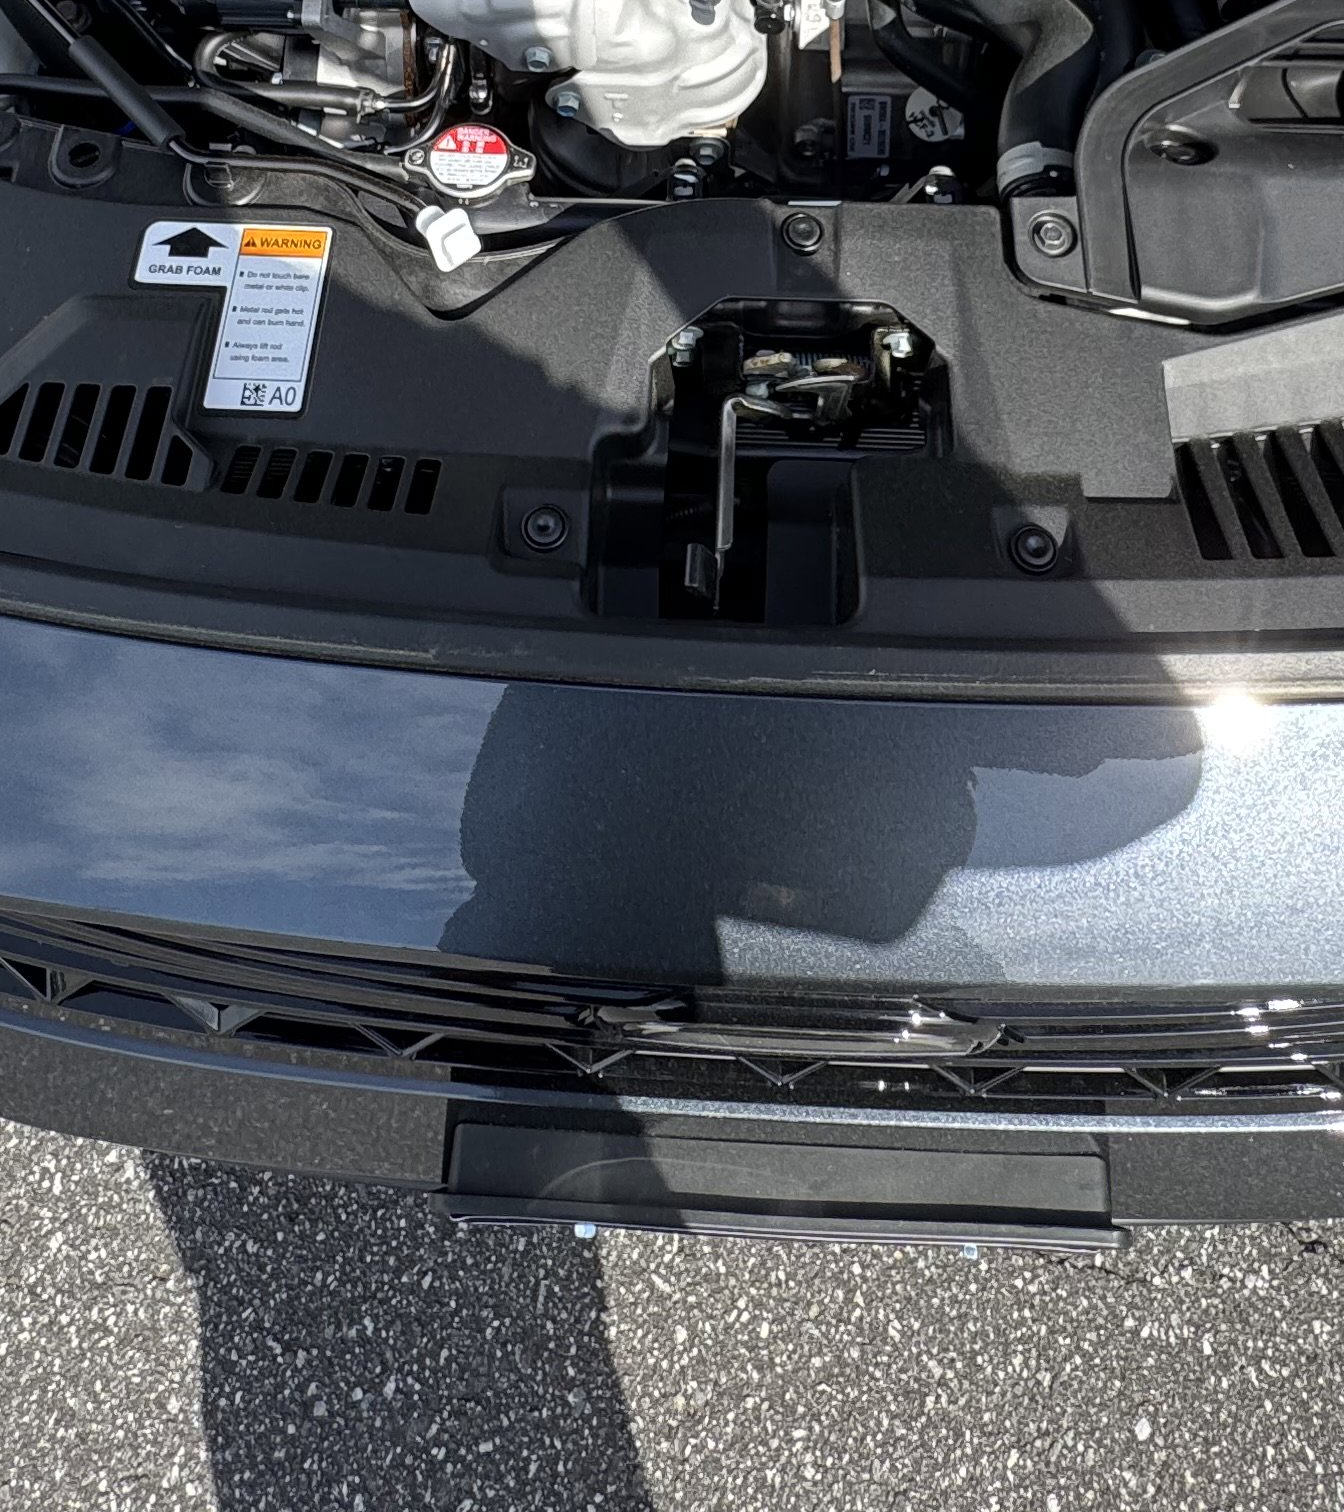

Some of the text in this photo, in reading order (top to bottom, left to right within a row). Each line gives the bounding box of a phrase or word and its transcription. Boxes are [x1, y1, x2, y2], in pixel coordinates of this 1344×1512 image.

[260, 238, 322, 250] WARNING
[148, 264, 222, 276] GRAB FOAM
[268, 385, 297, 406] A0
